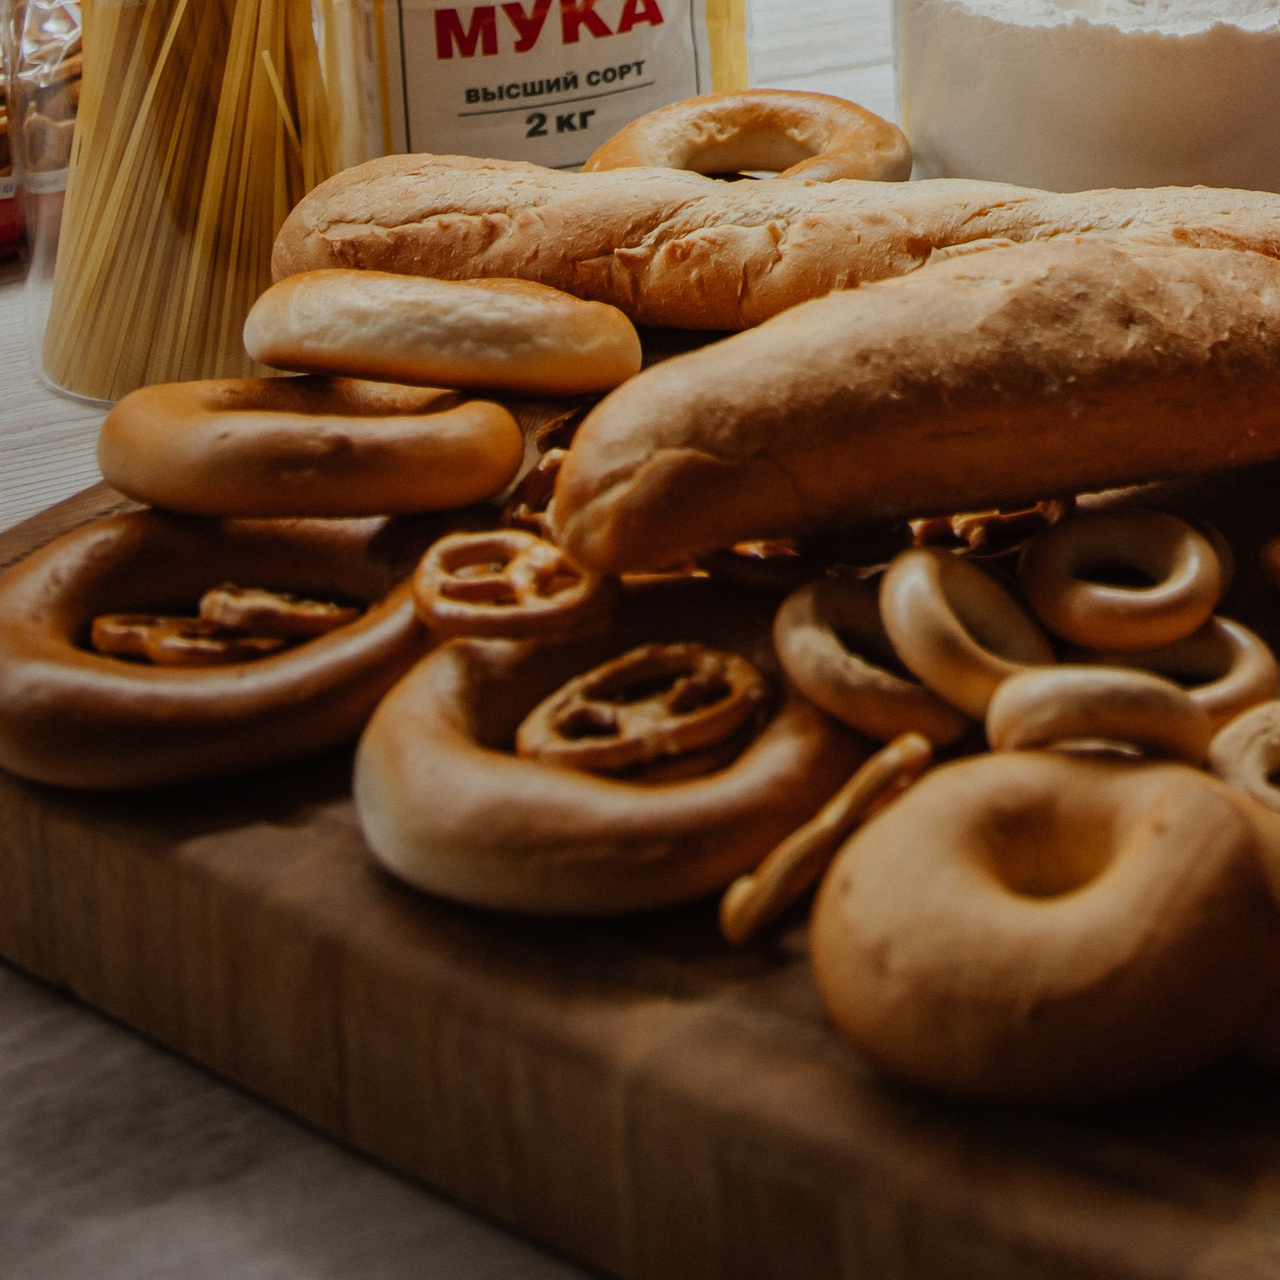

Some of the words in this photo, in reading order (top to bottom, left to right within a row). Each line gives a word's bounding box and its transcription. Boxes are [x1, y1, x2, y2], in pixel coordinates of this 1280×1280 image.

[465, 70, 579, 104] ВЫСШИЙ
[585, 59, 646, 87] СОРТ
[525, 112, 548, 138] 2
